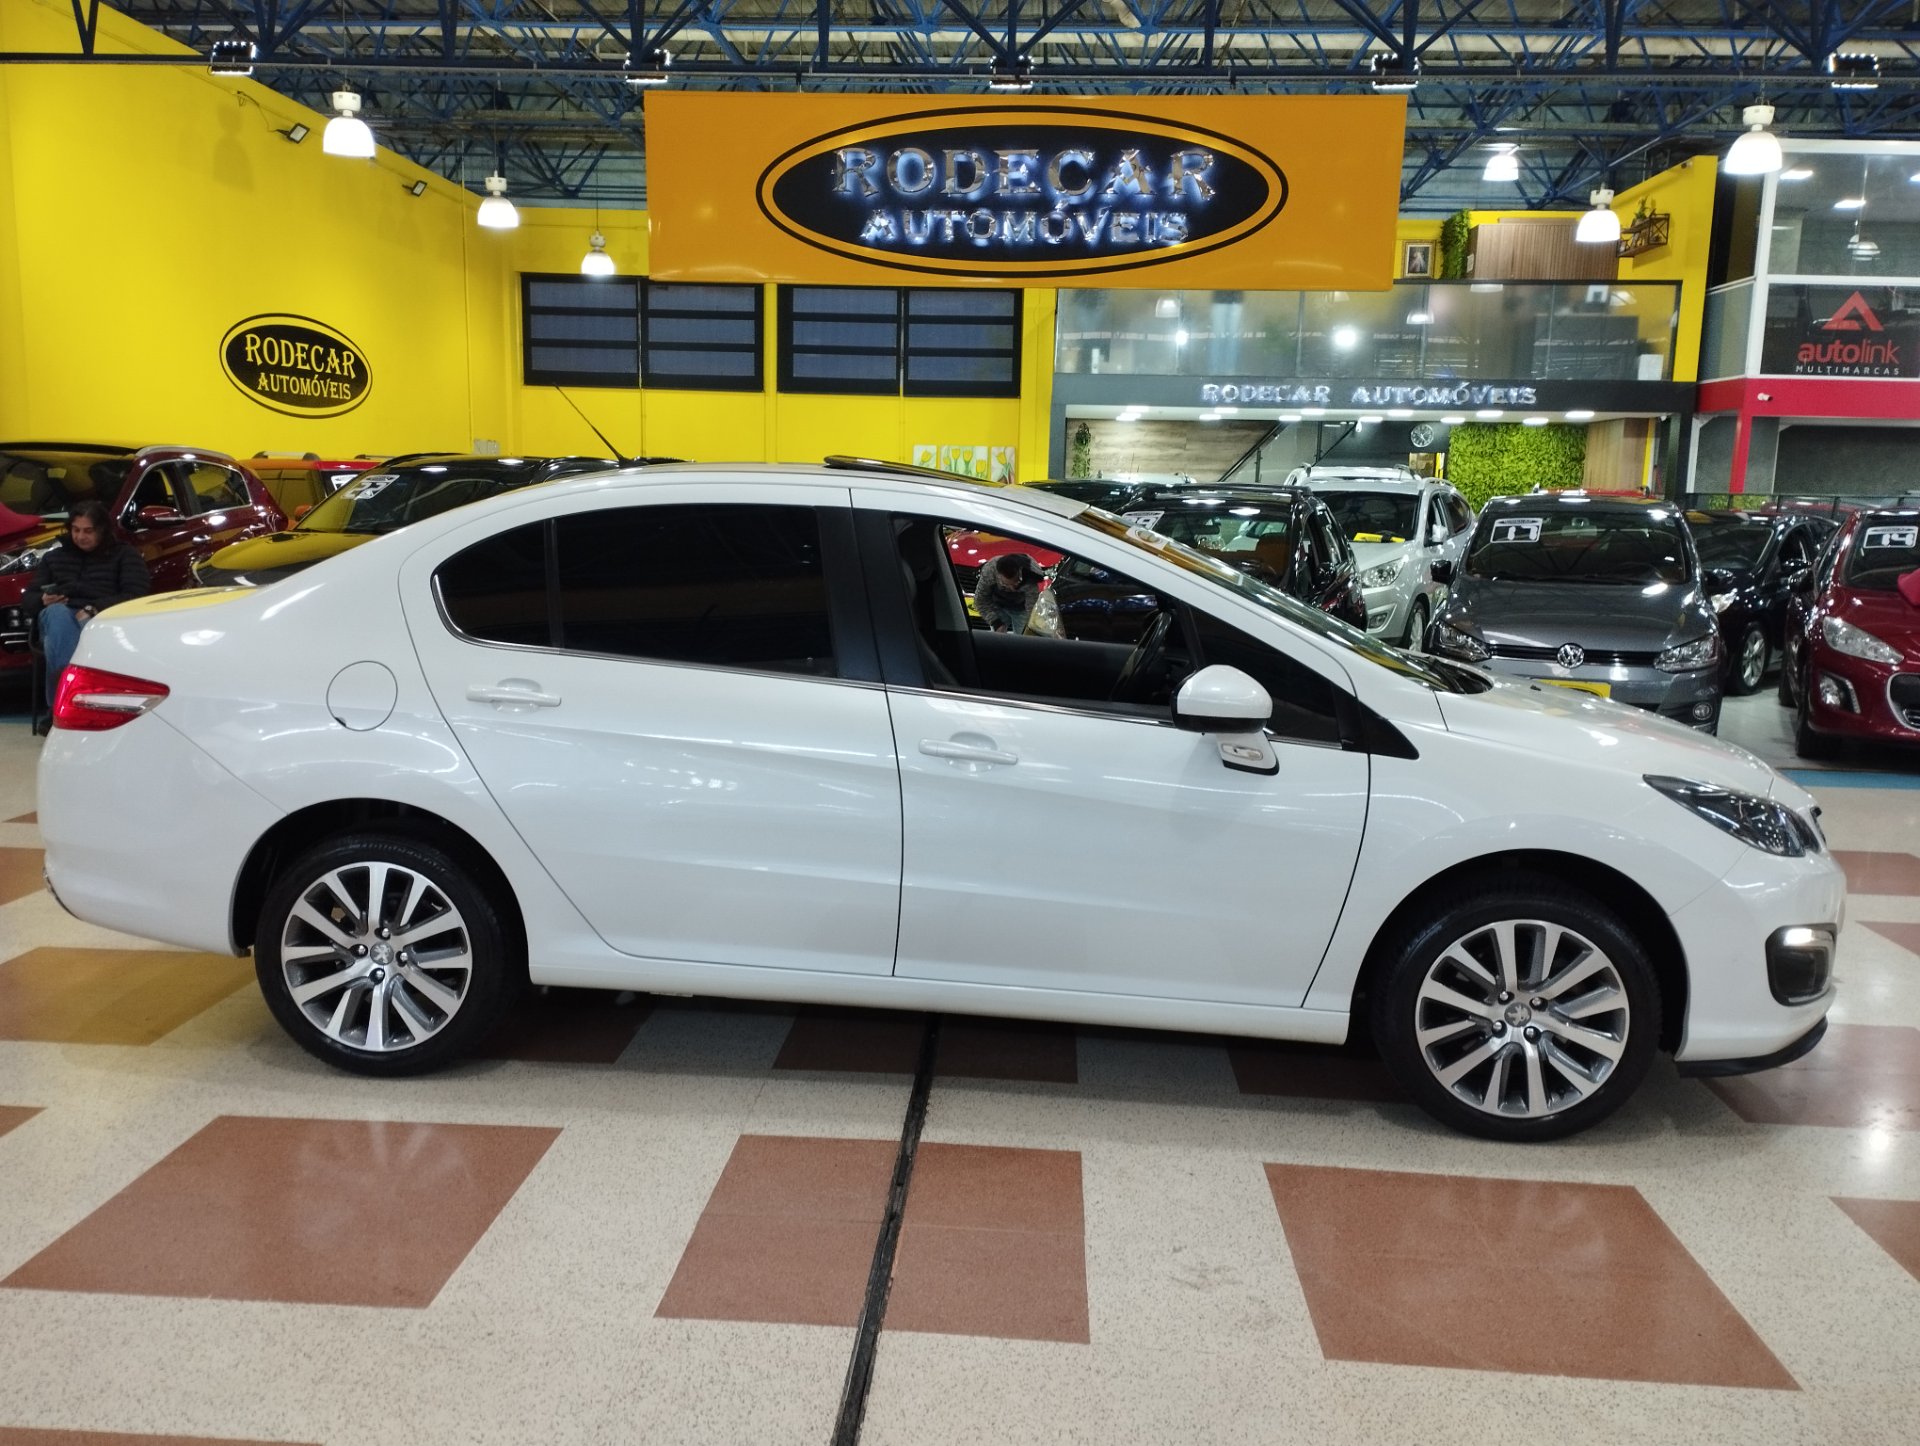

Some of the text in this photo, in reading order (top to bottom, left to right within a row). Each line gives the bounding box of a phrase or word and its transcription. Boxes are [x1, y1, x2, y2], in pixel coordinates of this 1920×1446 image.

[831, 147, 1216, 200] RODECAR
[859, 200, 1189, 243] AUTOMÓVEIS
[245, 333, 356, 379] RODECAR
[1797, 338, 1900, 364] autolink
[1795, 365, 1900, 375] MULTIMARCAS
[257, 372, 351, 400] AUTOMÓVEIS
[1202, 381, 1537, 404] RODECAR AUTOMÓVEIS
